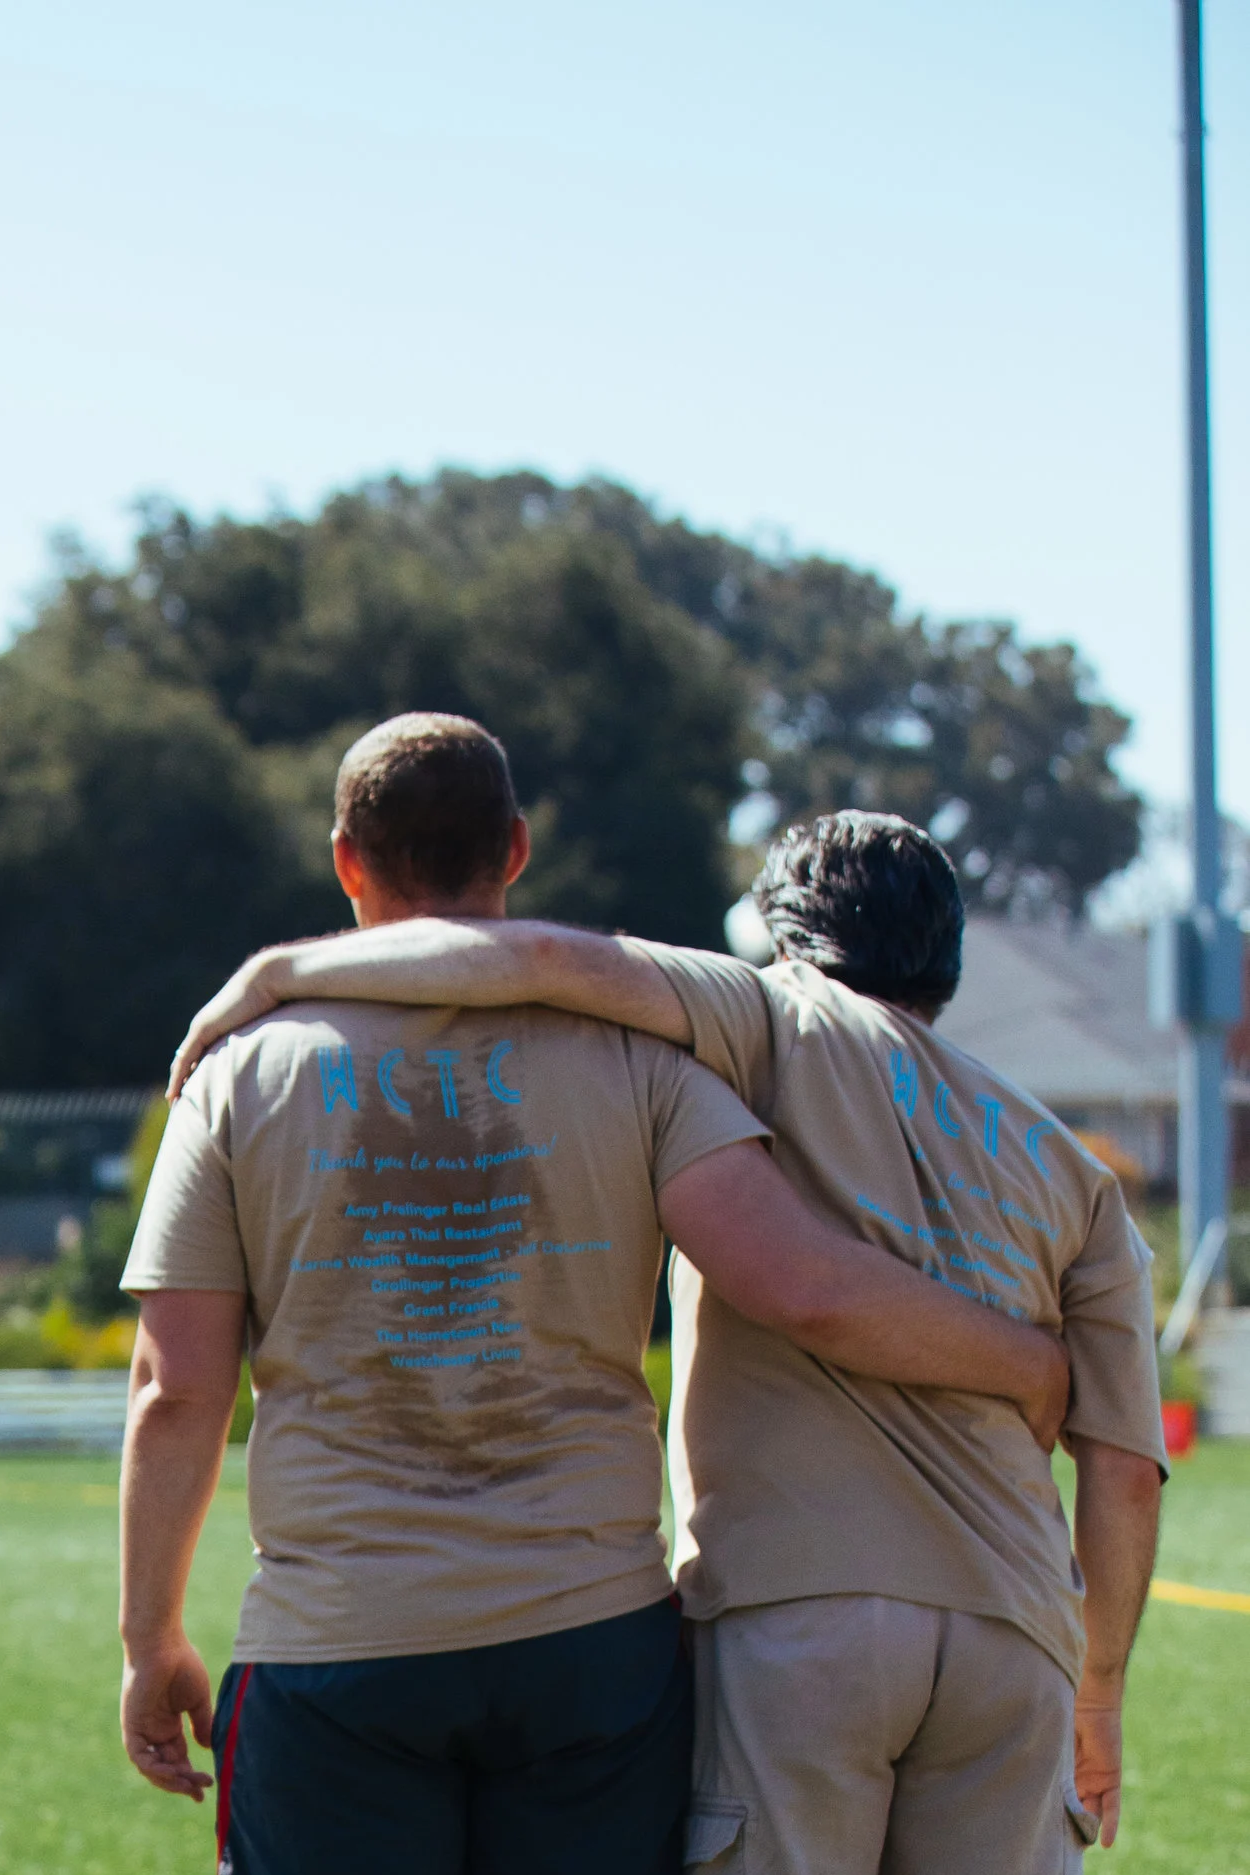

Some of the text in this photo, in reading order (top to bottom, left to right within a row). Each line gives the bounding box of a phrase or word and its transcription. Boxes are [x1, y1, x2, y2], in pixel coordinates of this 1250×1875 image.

[318, 1040, 522, 1118] WCTC
[308, 1146, 367, 1174] Thank
[373, 1156, 404, 1175] you
[410, 1151, 430, 1170] to
[436, 1156, 467, 1170] our
[345, 1204, 379, 1220] Amy
[453, 1201, 487, 1215] Real
[490, 1193, 532, 1211] Estate
[410, 1227, 440, 1241] Thai
[444, 1219, 523, 1241] Restaurant
[348, 1253, 400, 1268] Wealth
[405, 1247, 500, 1269] Management
[404, 1298, 500, 1318] Grant Francis
[376, 1329, 404, 1343] The
[407, 1326, 487, 1342] Hometown
[390, 1347, 521, 1368] Westchester Living
